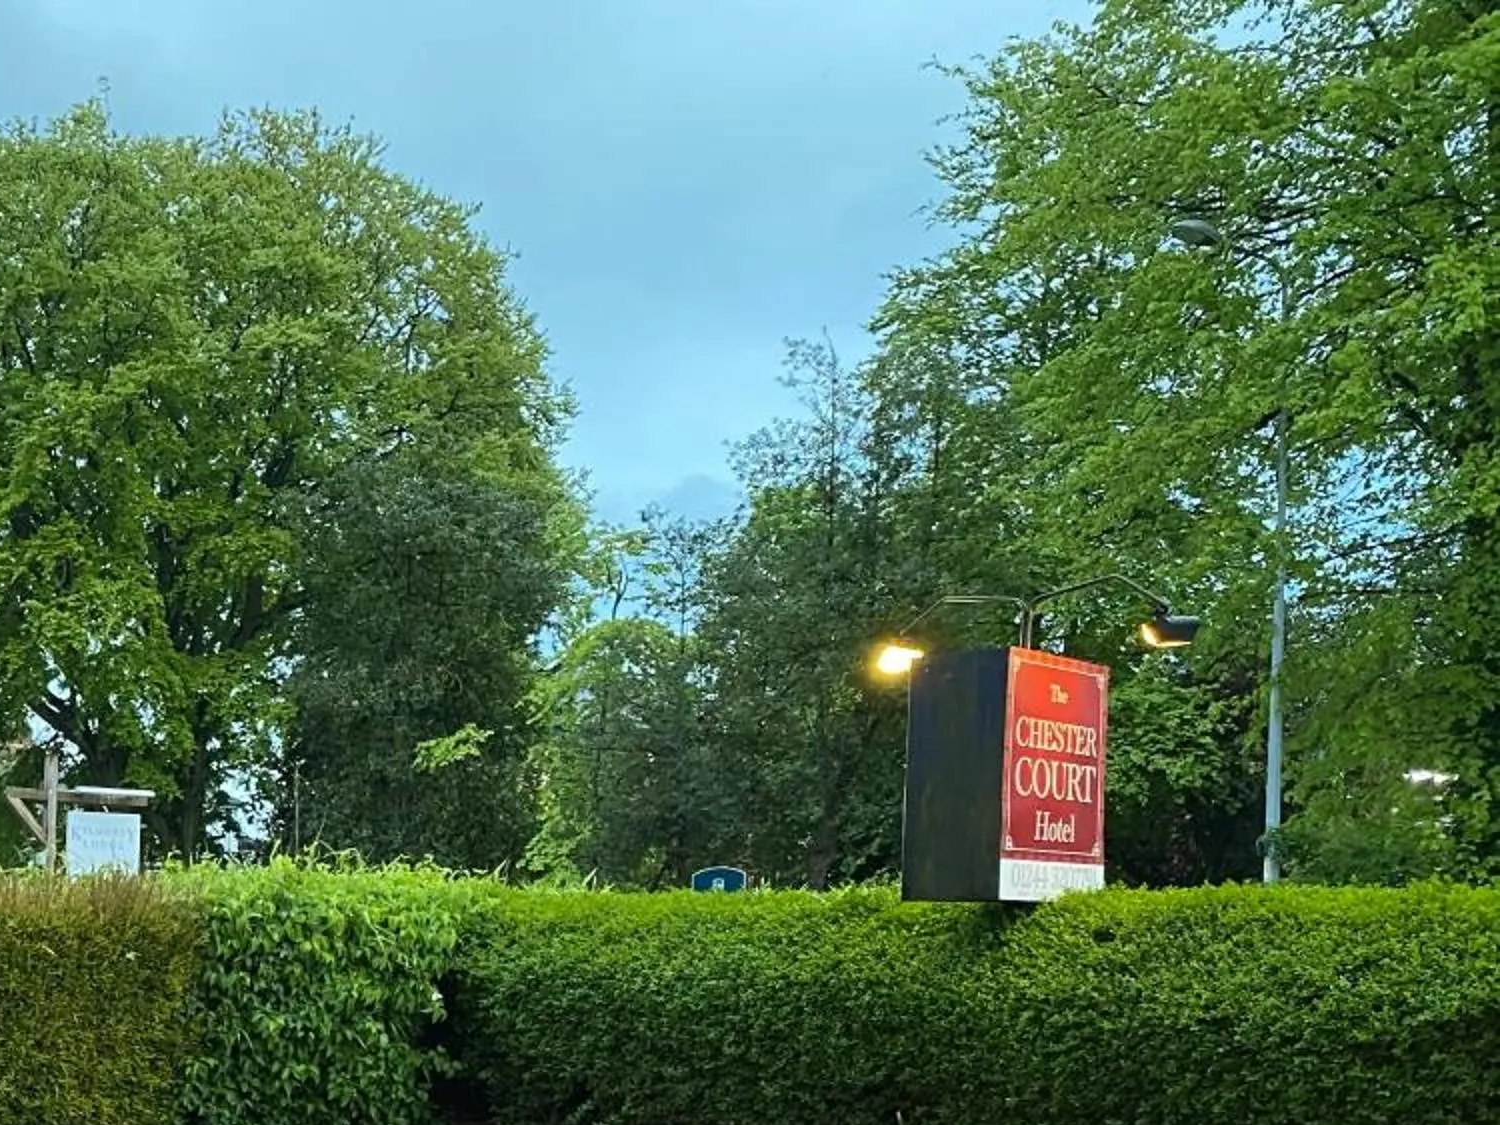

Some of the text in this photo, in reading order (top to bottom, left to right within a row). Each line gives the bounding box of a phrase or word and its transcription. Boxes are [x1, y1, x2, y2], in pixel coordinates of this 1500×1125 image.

[1050, 684, 1068, 704] The
[1016, 715, 1097, 758] CHESTER
[1014, 757, 1096, 803] COURT
[1033, 810, 1075, 843] Hotel
